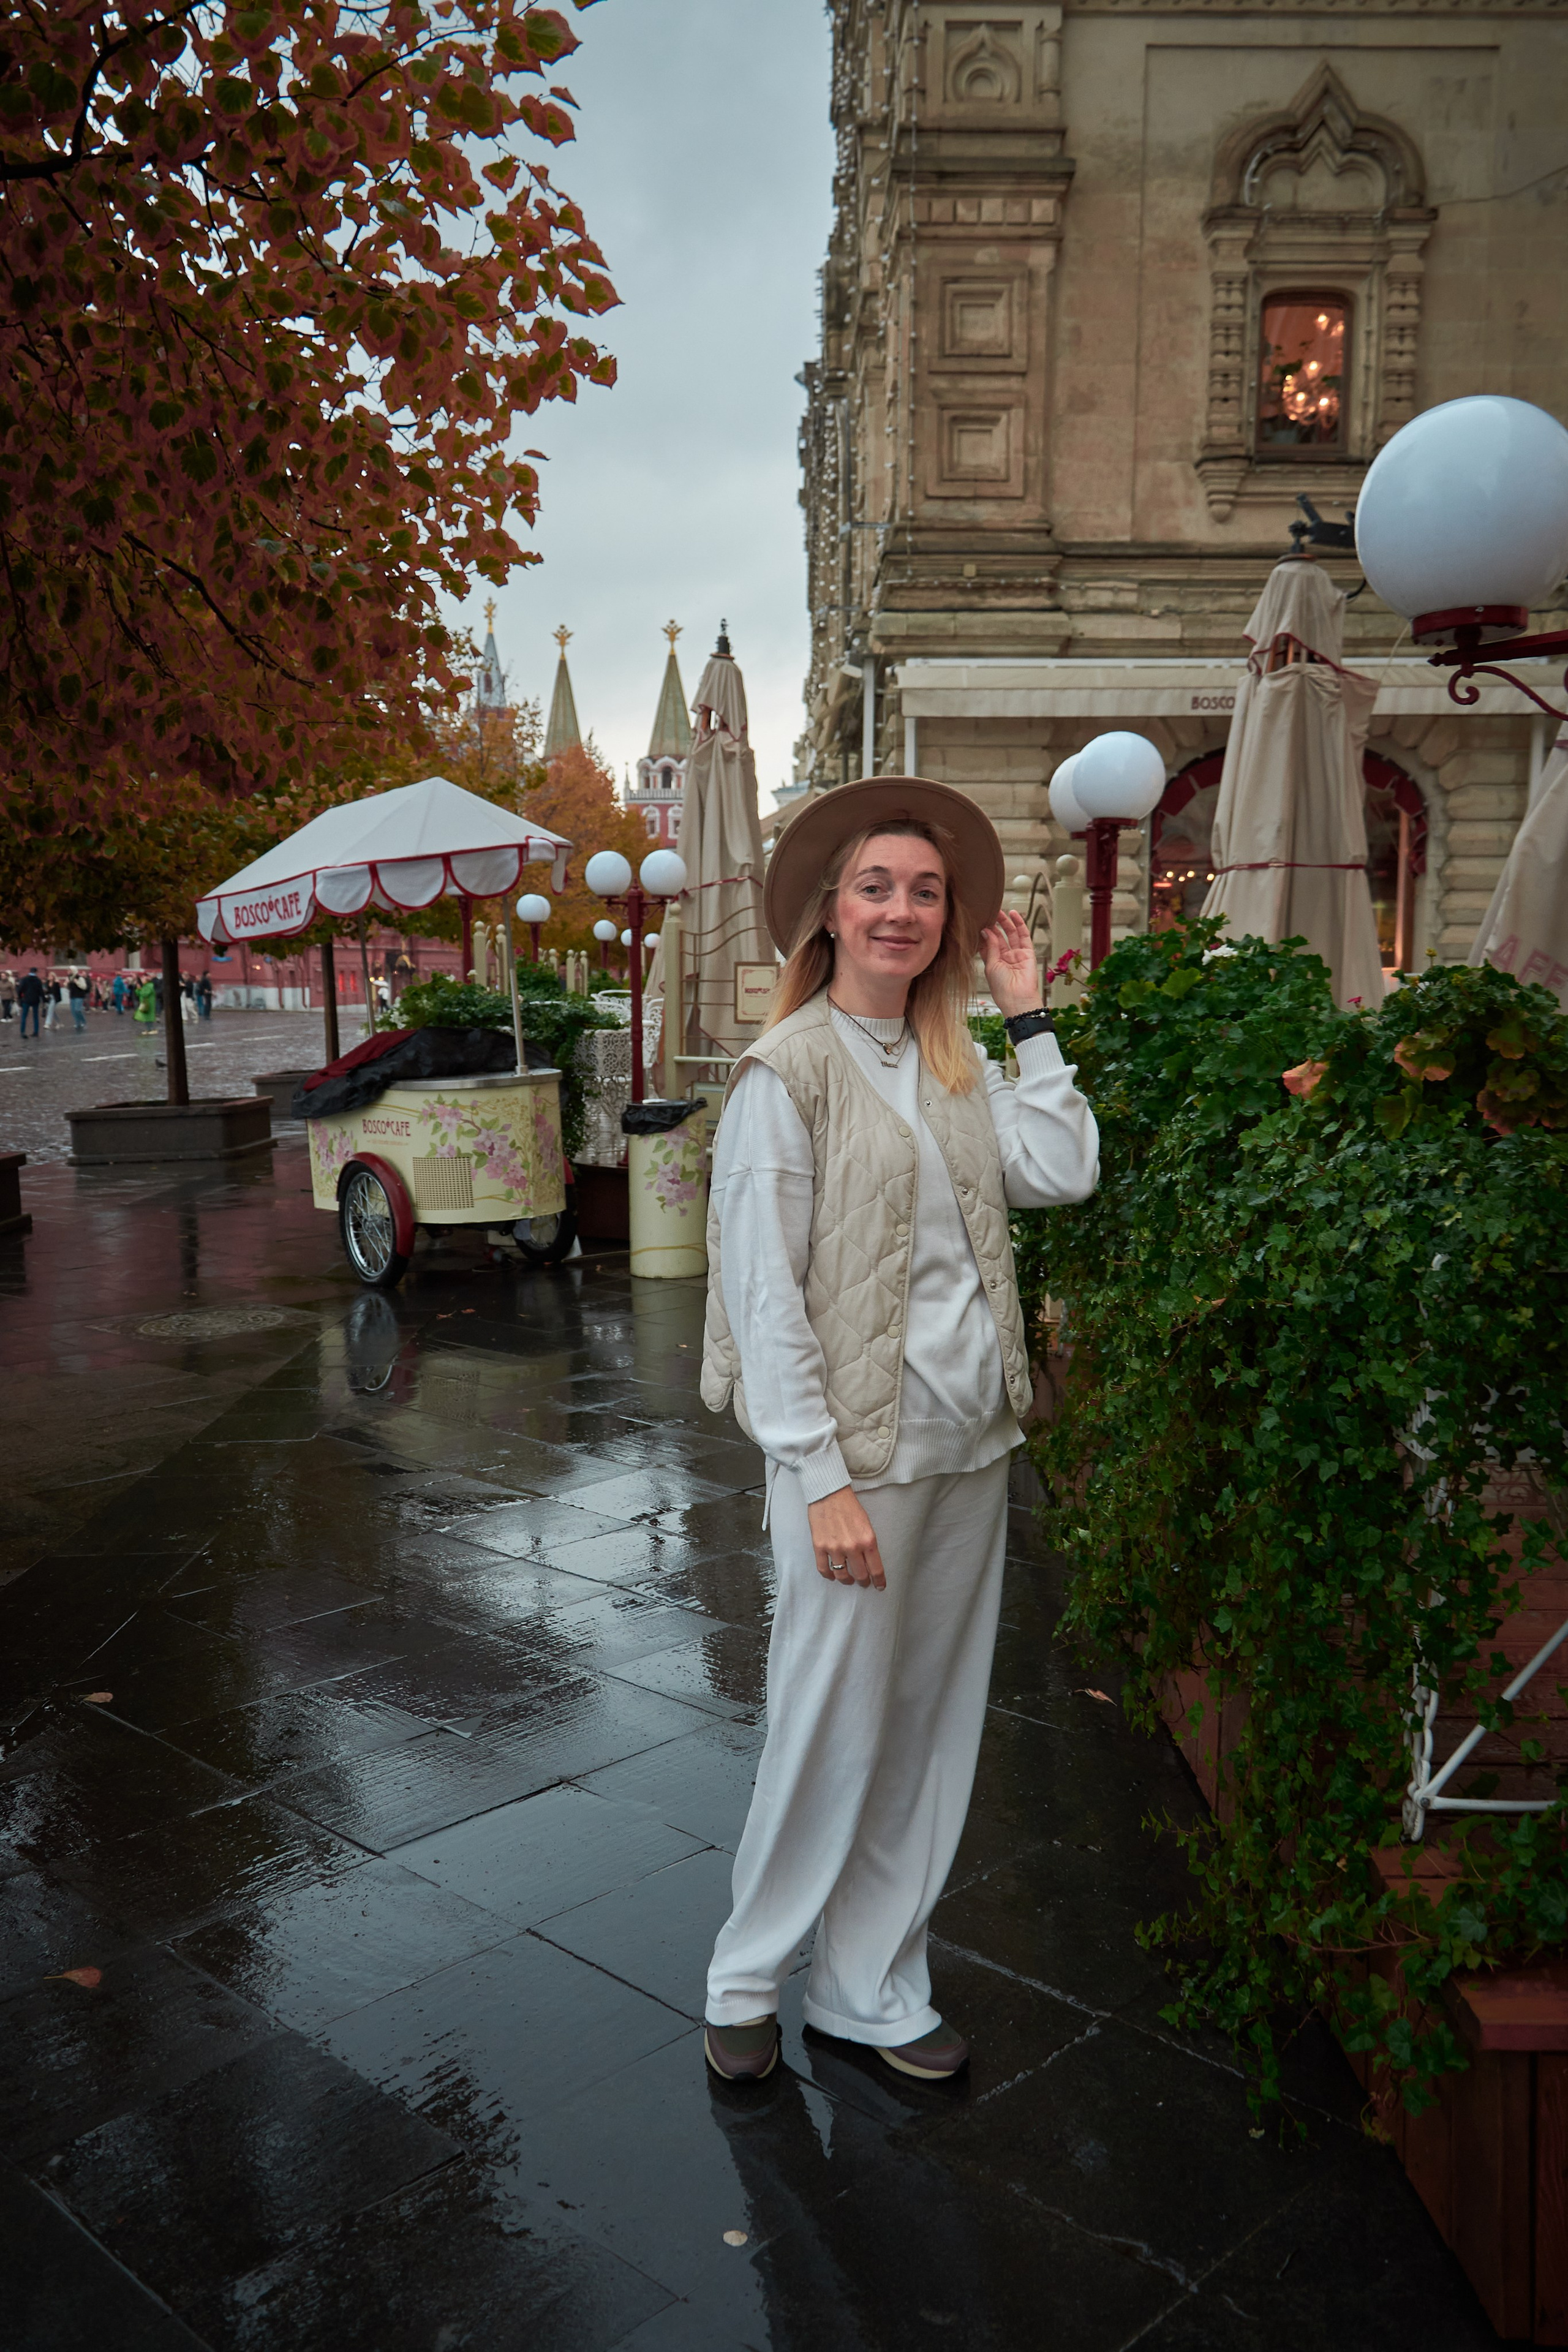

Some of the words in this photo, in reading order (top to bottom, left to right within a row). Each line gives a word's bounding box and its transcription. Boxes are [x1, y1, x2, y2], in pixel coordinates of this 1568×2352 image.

[1191, 696, 1235, 709] BOSCO
[234, 901, 270, 929] BOSCO
[274, 891, 301, 921] CAFE
[362, 1119, 386, 1134] BOSCO
[390, 1121, 411, 1136] CAFE
